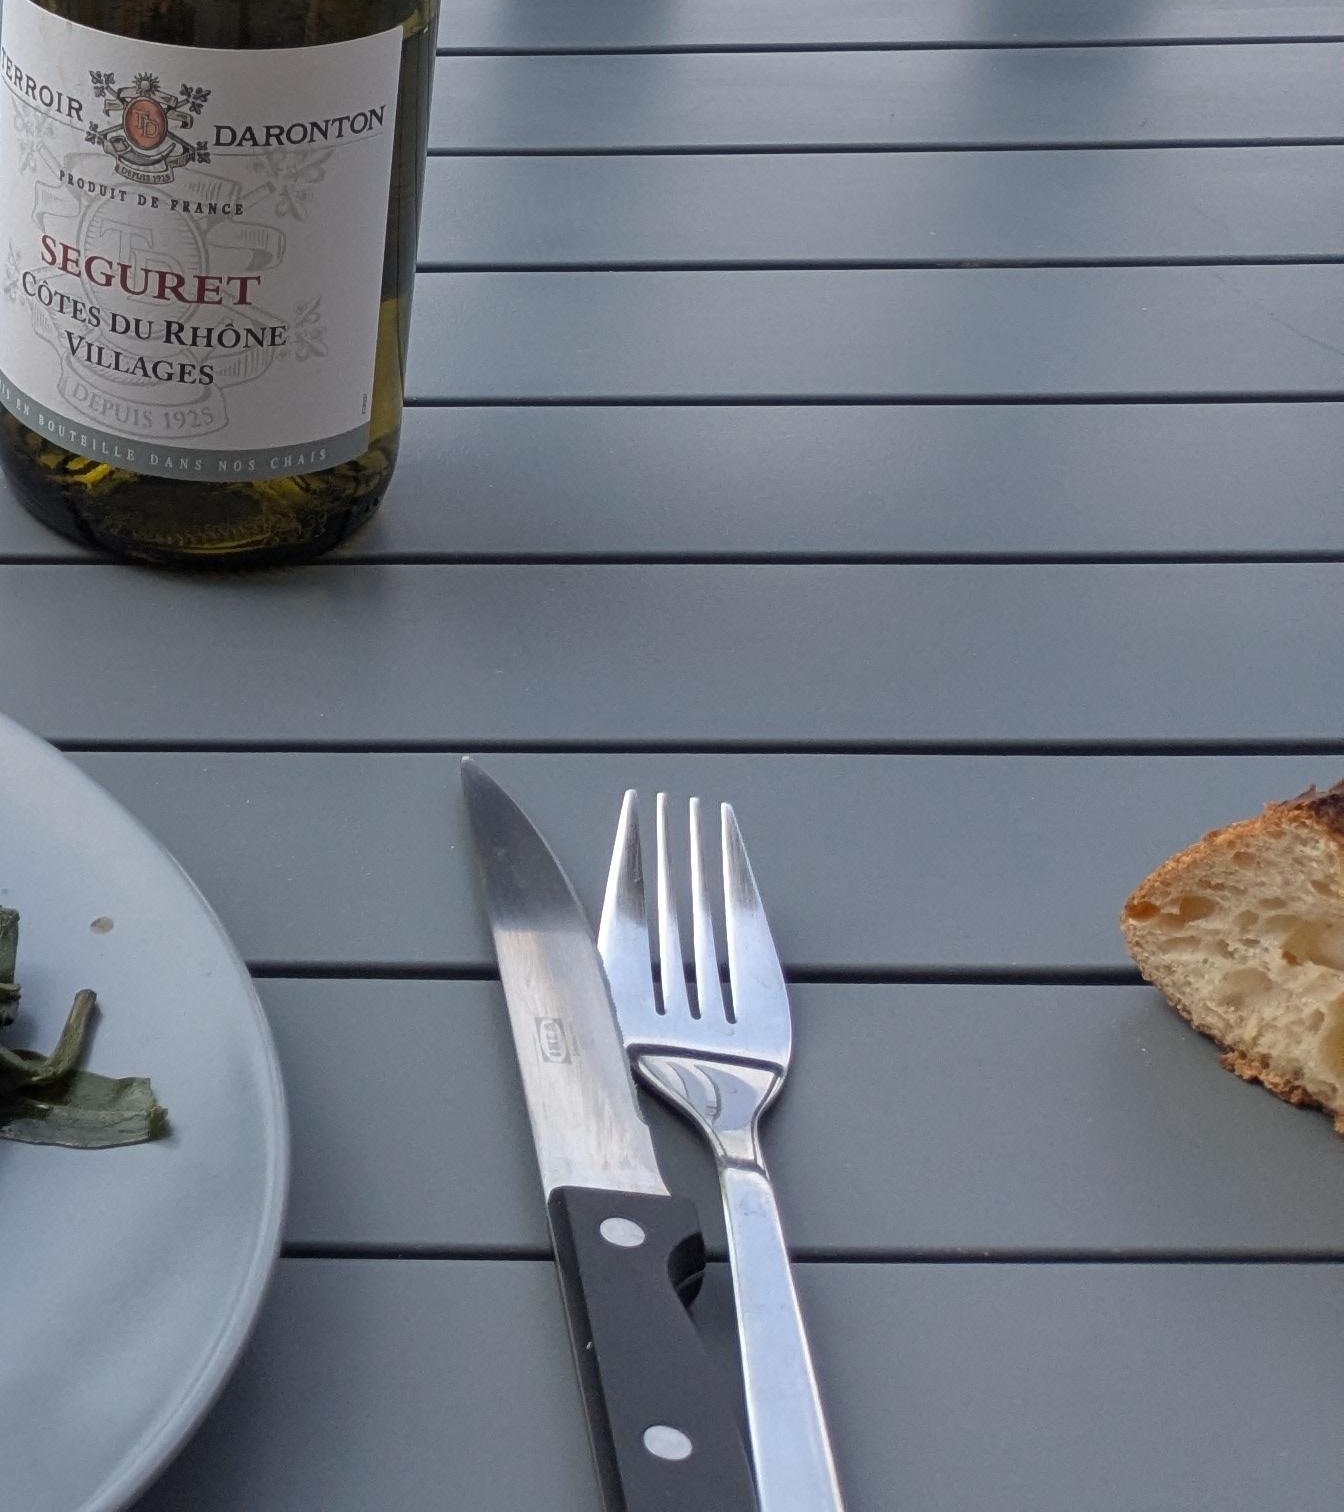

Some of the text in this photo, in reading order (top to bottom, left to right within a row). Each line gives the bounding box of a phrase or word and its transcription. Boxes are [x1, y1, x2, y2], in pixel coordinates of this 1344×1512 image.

[1, 47, 387, 148] TERROIR DARONTON
[59, 170, 245, 216] PRODUIT DE FRANCE
[40, 234, 262, 306] SEGURET
[21, 271, 289, 349] CÔTES DU RHÔNE
[64, 330, 214, 386] VILLAGES
[72, 384, 213, 430] DEPUIS 1925
[38, 413, 136, 461] BOUTEILLE
[150, 453, 202, 472] DANS
[218, 459, 256, 472] NOS
[269, 447, 328, 470] CHAIS
